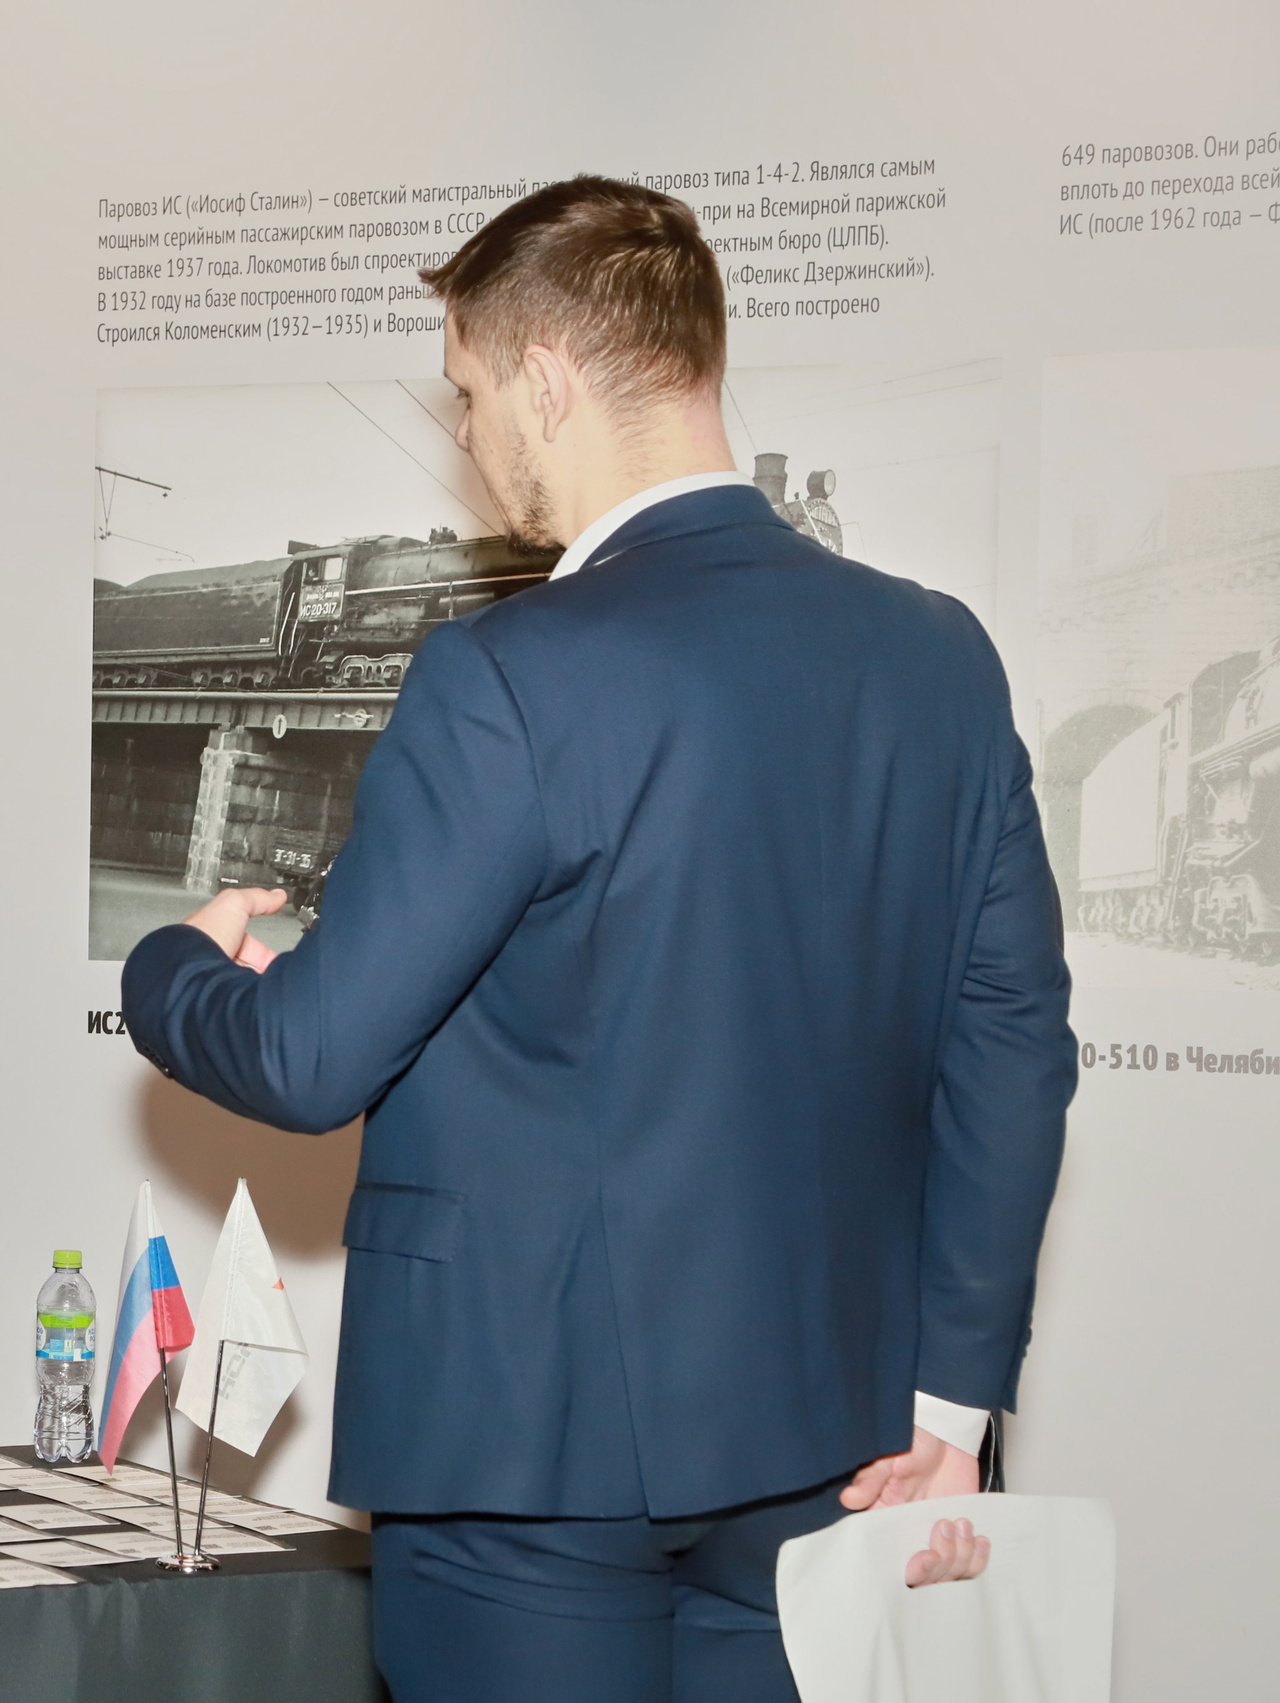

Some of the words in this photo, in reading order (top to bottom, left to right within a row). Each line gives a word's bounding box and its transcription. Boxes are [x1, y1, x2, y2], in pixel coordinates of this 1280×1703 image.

[1061, 143, 1096, 167] 649
[1102, 142, 1198, 168] паровозов.
[1204, 135, 1240, 158] Они
[1246, 131, 1280, 160] раб
[646, 172, 709, 194] паровоз
[714, 168, 750, 187] типа
[757, 161, 805, 185] 1-4-2.
[810, 160, 875, 182] Являлся
[880, 158, 935, 179] самым
[1060, 182, 1119, 201] вплоть
[1123, 180, 1144, 201] до
[1151, 174, 1234, 199] перехода
[99, 199, 158, 222] Паровоз
[162, 195, 182, 215] ИС
[186, 193, 246, 219] («Иосиф
[250, 189, 313, 213] Сталин»)
[333, 184, 407, 208] советский
[412, 178, 527, 203] магистральный
[692, 204, 731, 226] -при
[737, 201, 755, 220] на
[761, 194, 851, 220] Всемирной
[856, 188, 947, 215] парижской
[99, 233, 160, 251] мощным
[164, 226, 235, 251] серийным
[240, 223, 344, 246] пассажирским
[349, 220, 429, 242] паровозом
[434, 219, 442, 234] в
[447, 212, 486, 233] СССР
[1060, 213, 1084, 235] ИС
[1089, 212, 1144, 239] (после
[1151, 207, 1196, 230] 1962
[1203, 209, 1242, 230] года
[1268, 201, 1280, 224] Ф
[706, 235, 773, 253] оектным
[778, 229, 821, 254] бюро
[827, 224, 888, 253] (ЦЛПБ).
[98, 263, 161, 281] выставке
[167, 257, 204, 278] 1937
[208, 260, 243, 279] года.
[247, 255, 326, 275] Локомотив
[331, 251, 359, 271] был
[726, 263, 800, 291] («Феликс
[804, 256, 934, 286] Дзержинский»).
[97, 292, 106, 311] В
[111, 290, 146, 311] 1932
[151, 294, 182, 314] году
[185, 293, 201, 308] на
[205, 288, 237, 308] базе
[241, 288, 337, 310] построенного
[341, 285, 384, 305] годом
[388, 284, 435, 306] раньш
[725, 304, 742, 320] и.
[747, 297, 790, 318] Всего
[795, 296, 880, 319] построено
[97, 323, 160, 347] Строился
[165, 321, 262, 341] Коломенским
[373, 318, 382, 333] и
[388, 312, 445, 336] Вороши
[87, 1010, 126, 1035] ИС2
[1081, 1042, 1158, 1071] 0-510
[1165, 1052, 1180, 1071] в
[1186, 1046, 1280, 1075] Челяби
